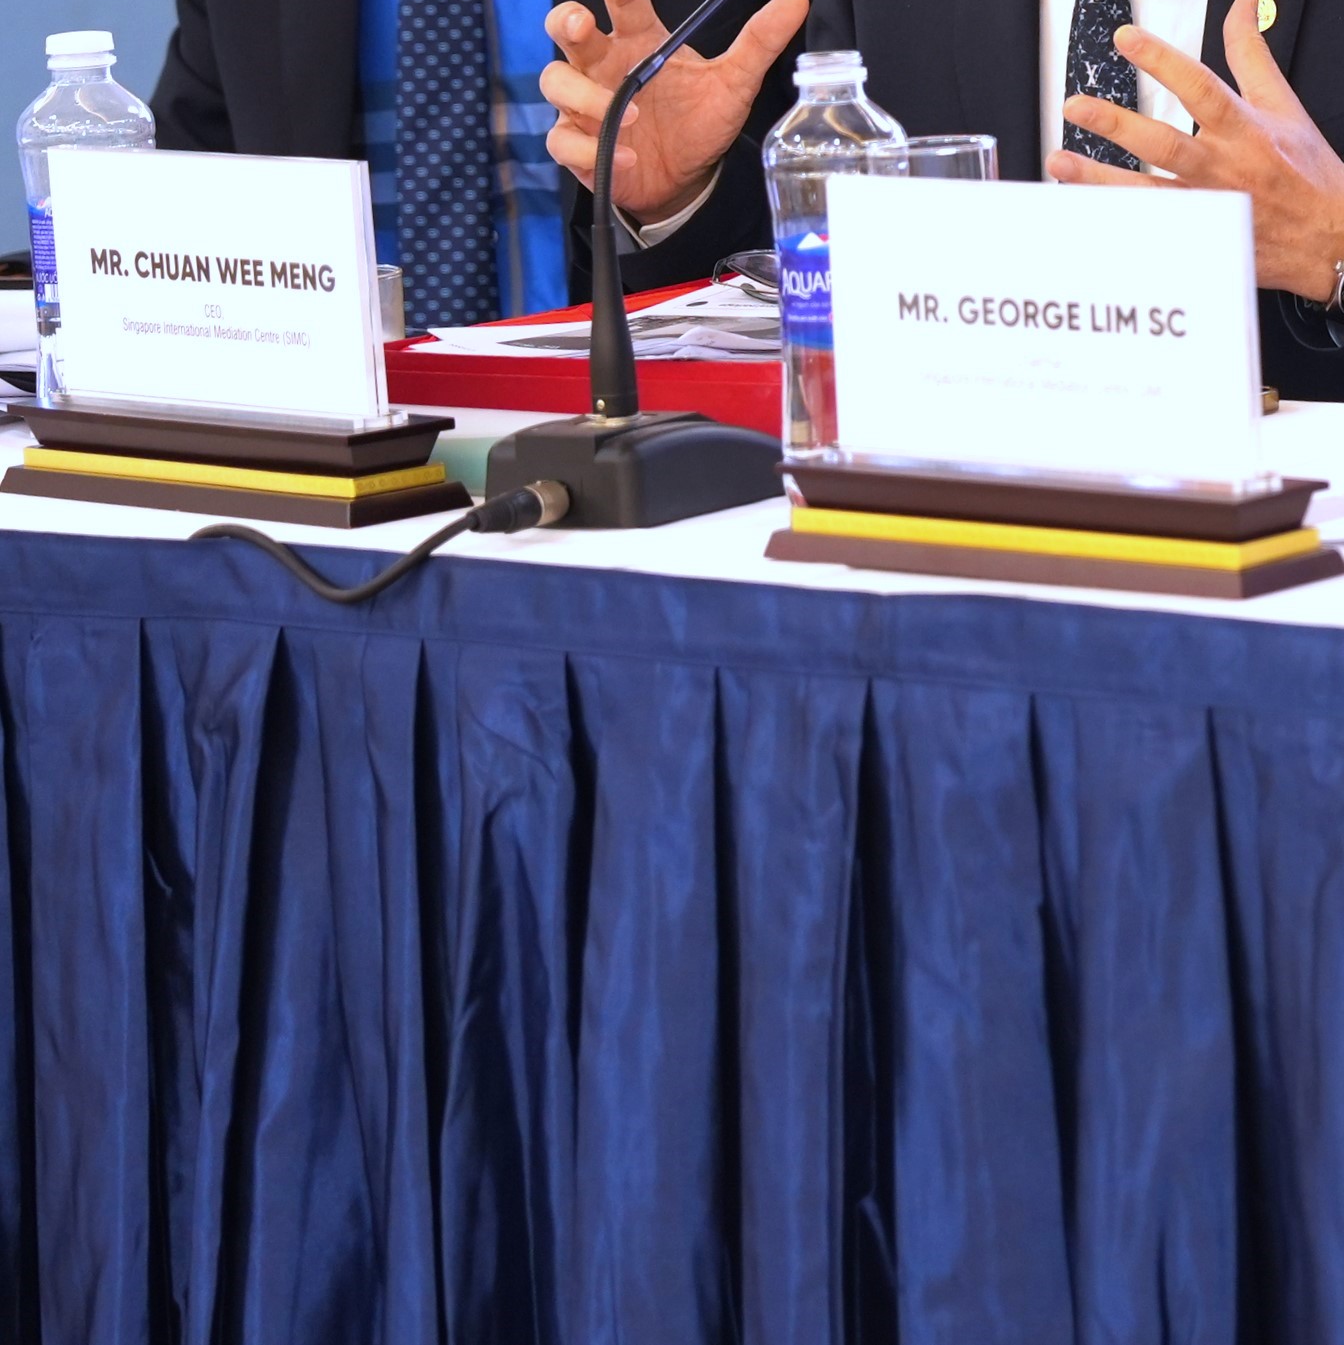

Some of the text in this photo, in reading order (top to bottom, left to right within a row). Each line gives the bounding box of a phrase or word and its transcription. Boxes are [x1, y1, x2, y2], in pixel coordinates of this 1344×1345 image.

[90, 248, 336, 293] MR. CHUAN WEE MENG
[122, 317, 311, 349] Singapore International Mediation Centre (SIMC)
[898, 292, 1187, 338] MR. GEORGE LIM SC
